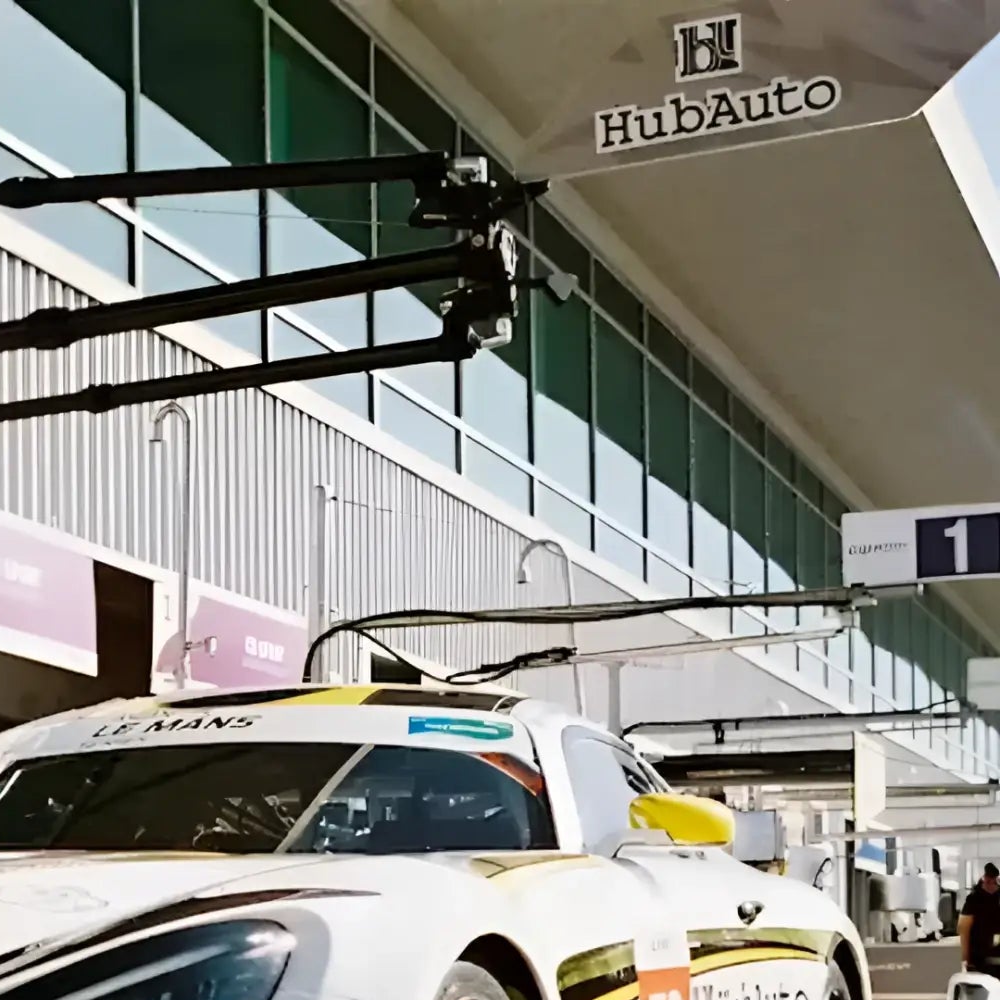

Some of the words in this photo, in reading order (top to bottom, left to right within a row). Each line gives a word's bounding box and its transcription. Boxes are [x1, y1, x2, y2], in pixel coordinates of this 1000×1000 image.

[599, 79, 837, 148] HubAuto
[943, 517, 969, 574] 1
[143, 714, 263, 734] MANS
